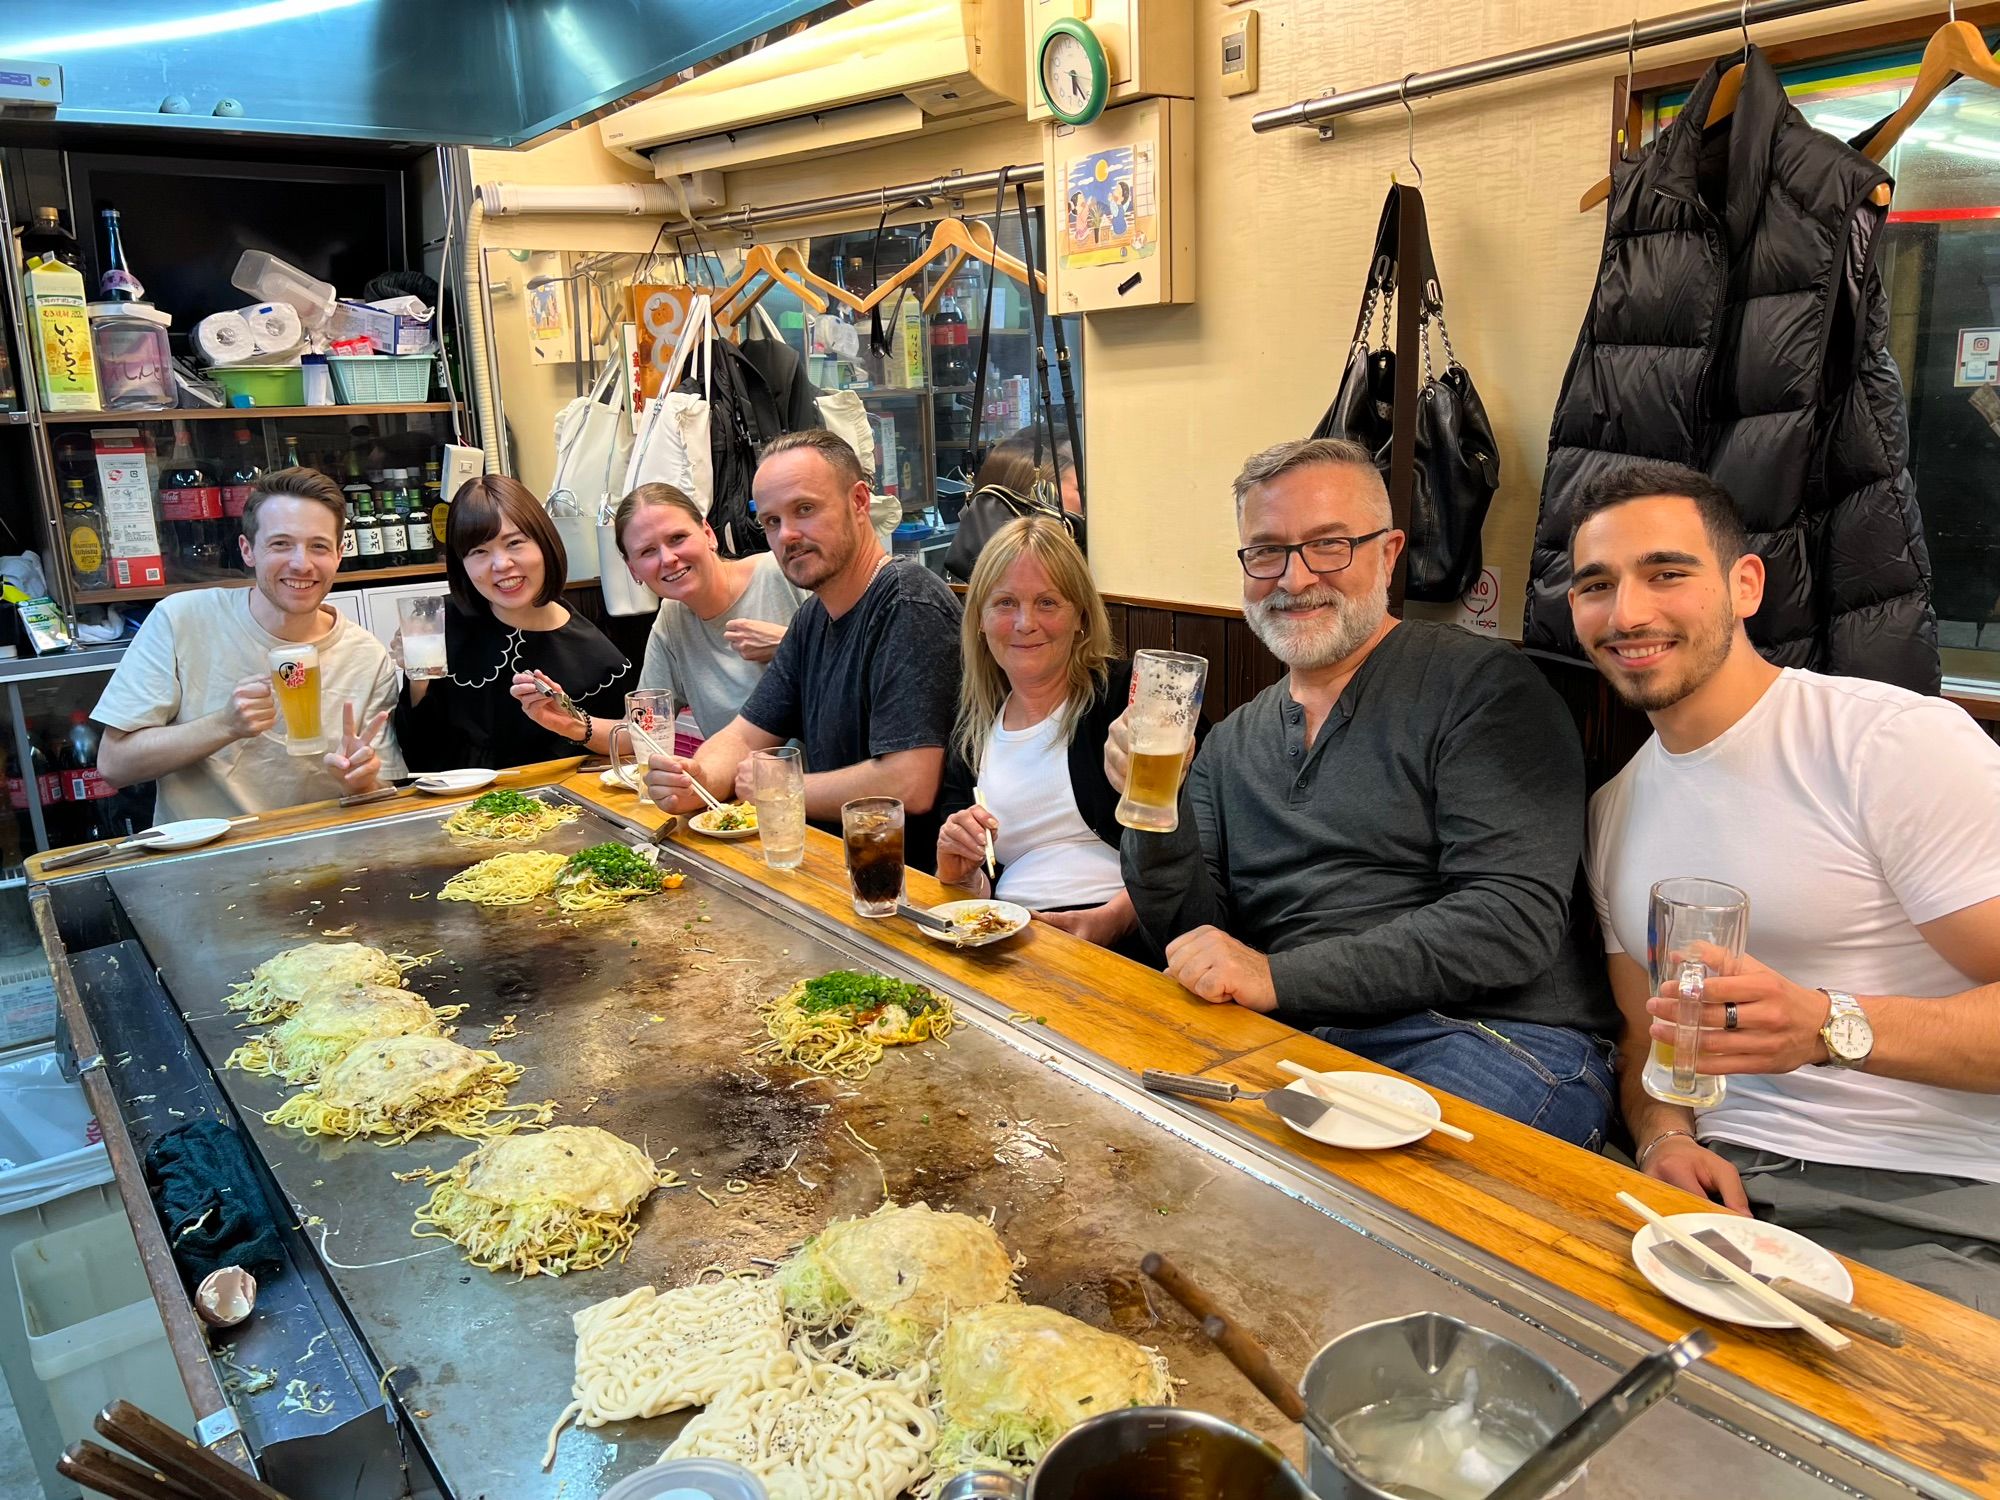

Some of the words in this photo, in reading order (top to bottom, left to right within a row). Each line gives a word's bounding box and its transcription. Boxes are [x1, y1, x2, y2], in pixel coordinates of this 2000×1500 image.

[54, 322, 77, 382] いいちこ
[370, 531, 380, 551] 白州
[396, 528, 405, 548] 白州
[1470, 581, 1488, 595] NO
